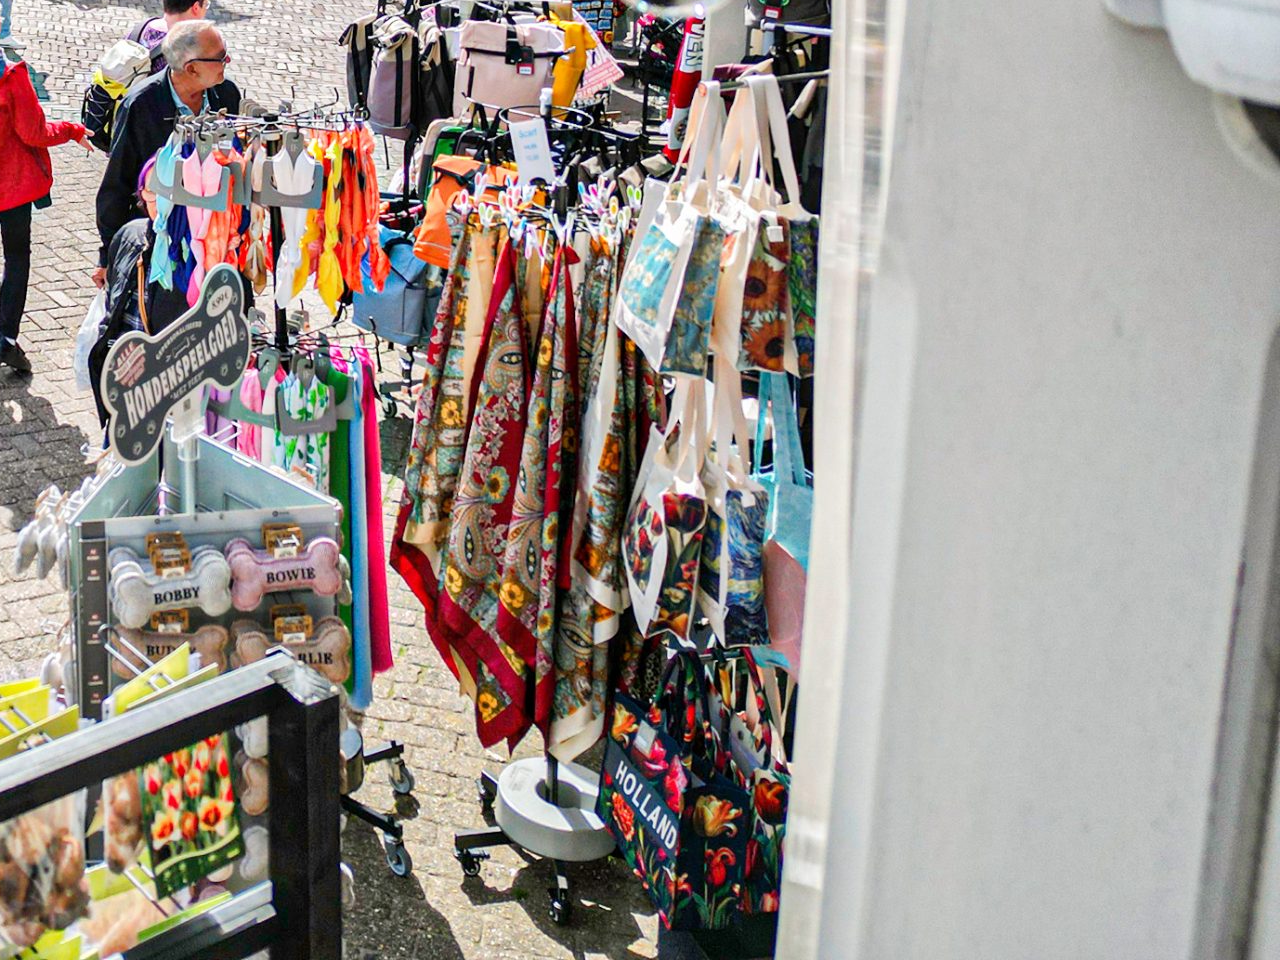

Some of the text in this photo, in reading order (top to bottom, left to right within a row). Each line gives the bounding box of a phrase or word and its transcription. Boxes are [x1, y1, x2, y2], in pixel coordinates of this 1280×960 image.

[123, 309, 238, 430] HONDENSPEELGOED
[266, 567, 316, 584] BOWIE
[154, 586, 200, 605] BOBBY
[297, 652, 333, 665] RLIE
[615, 760, 678, 850] HOLLAND
